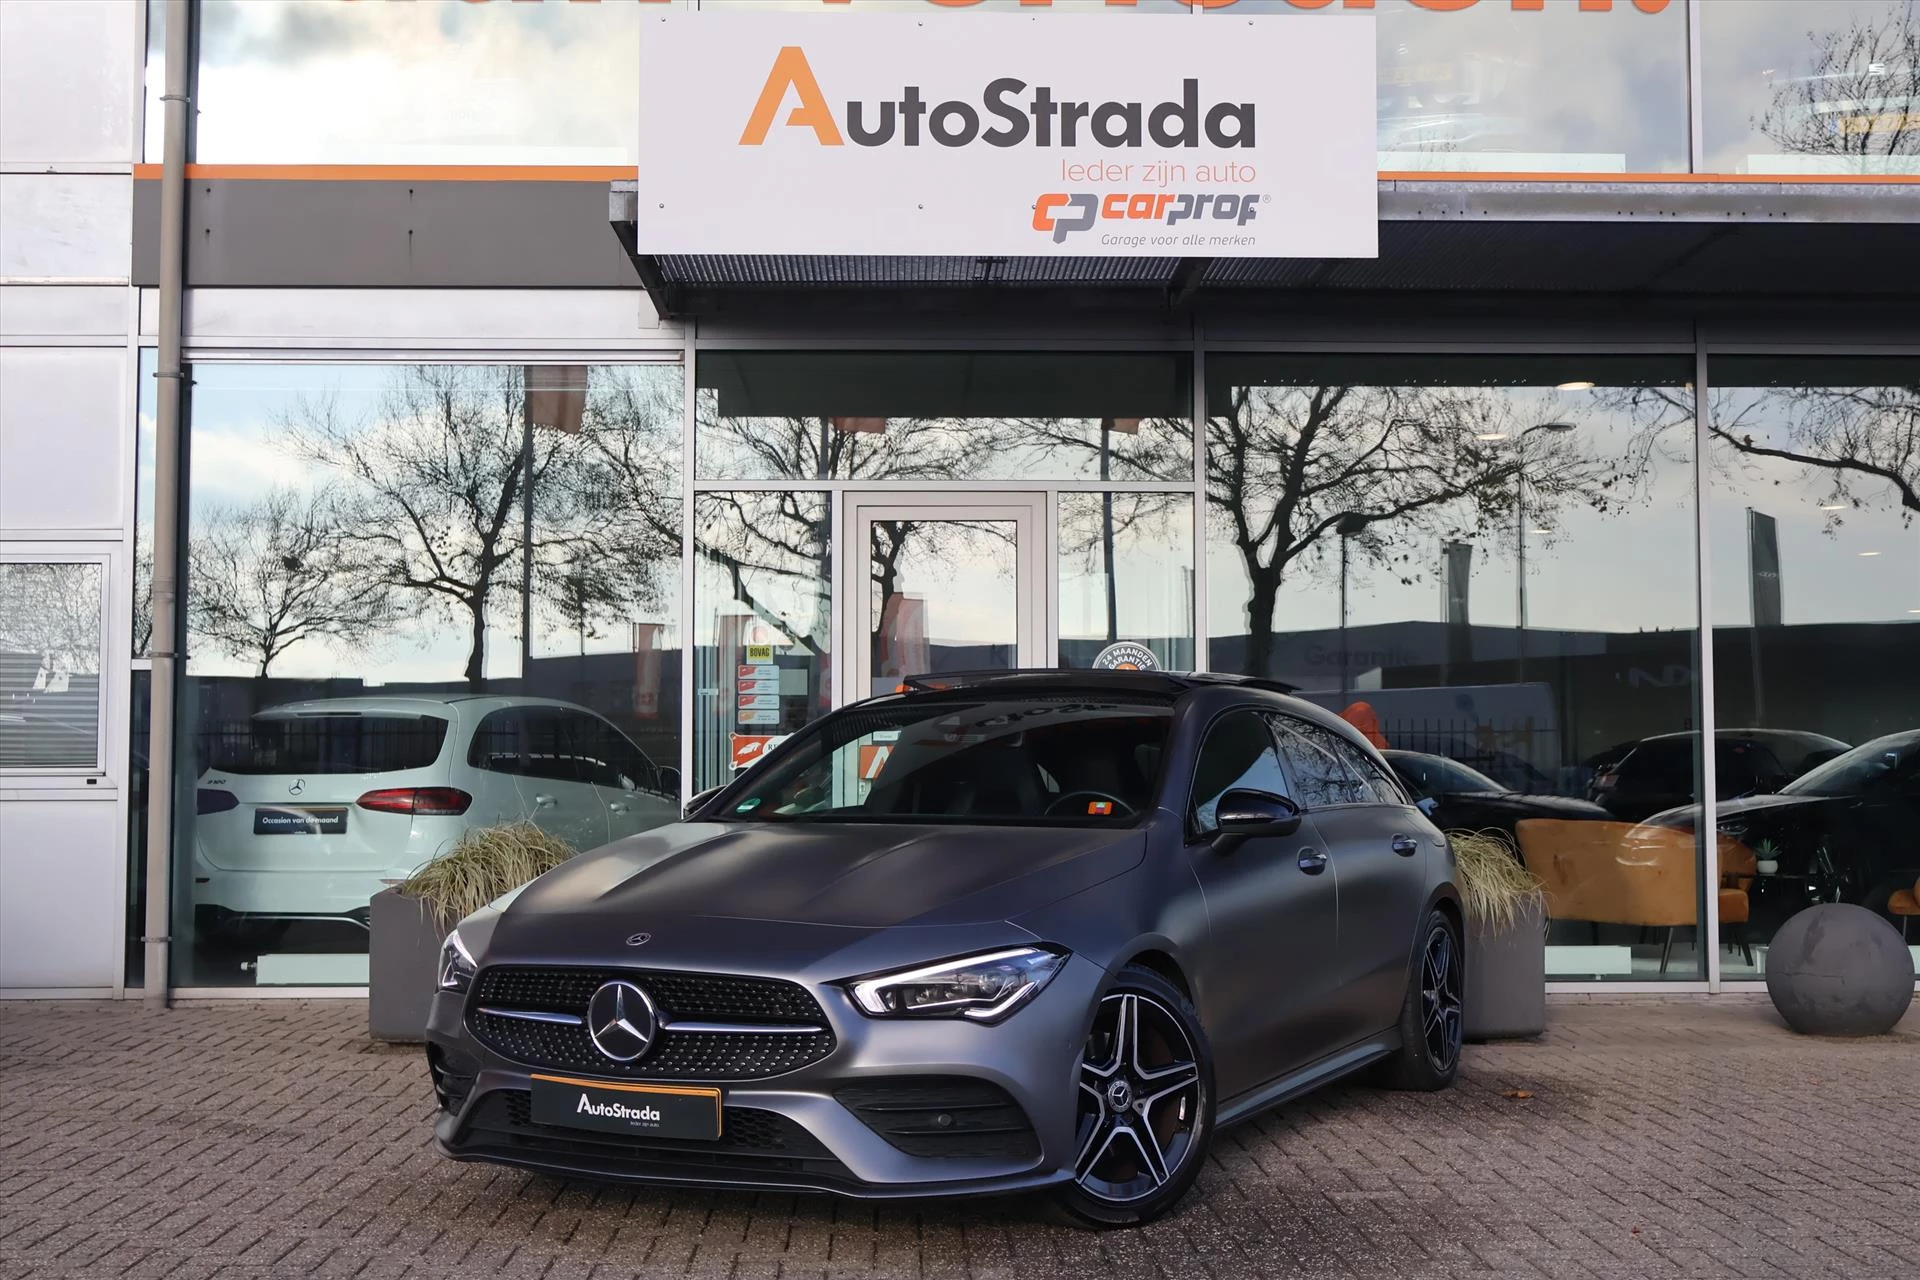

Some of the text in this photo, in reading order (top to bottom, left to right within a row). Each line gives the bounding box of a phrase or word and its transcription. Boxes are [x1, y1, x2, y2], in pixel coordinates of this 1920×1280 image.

[738, 46, 1256, 148] AutoStrada
[1062, 159, 1256, 188] Ieder zijn auto
[1101, 234, 1256, 248] Garage voor alle merken
[749, 647, 770, 657] BOVAG
[1102, 648, 1153, 666] 24 MAANDEN
[1108, 656, 1146, 670] GARANTIE
[262, 816, 291, 824] Occasion
[576, 1093, 660, 1121] AutoStrada
